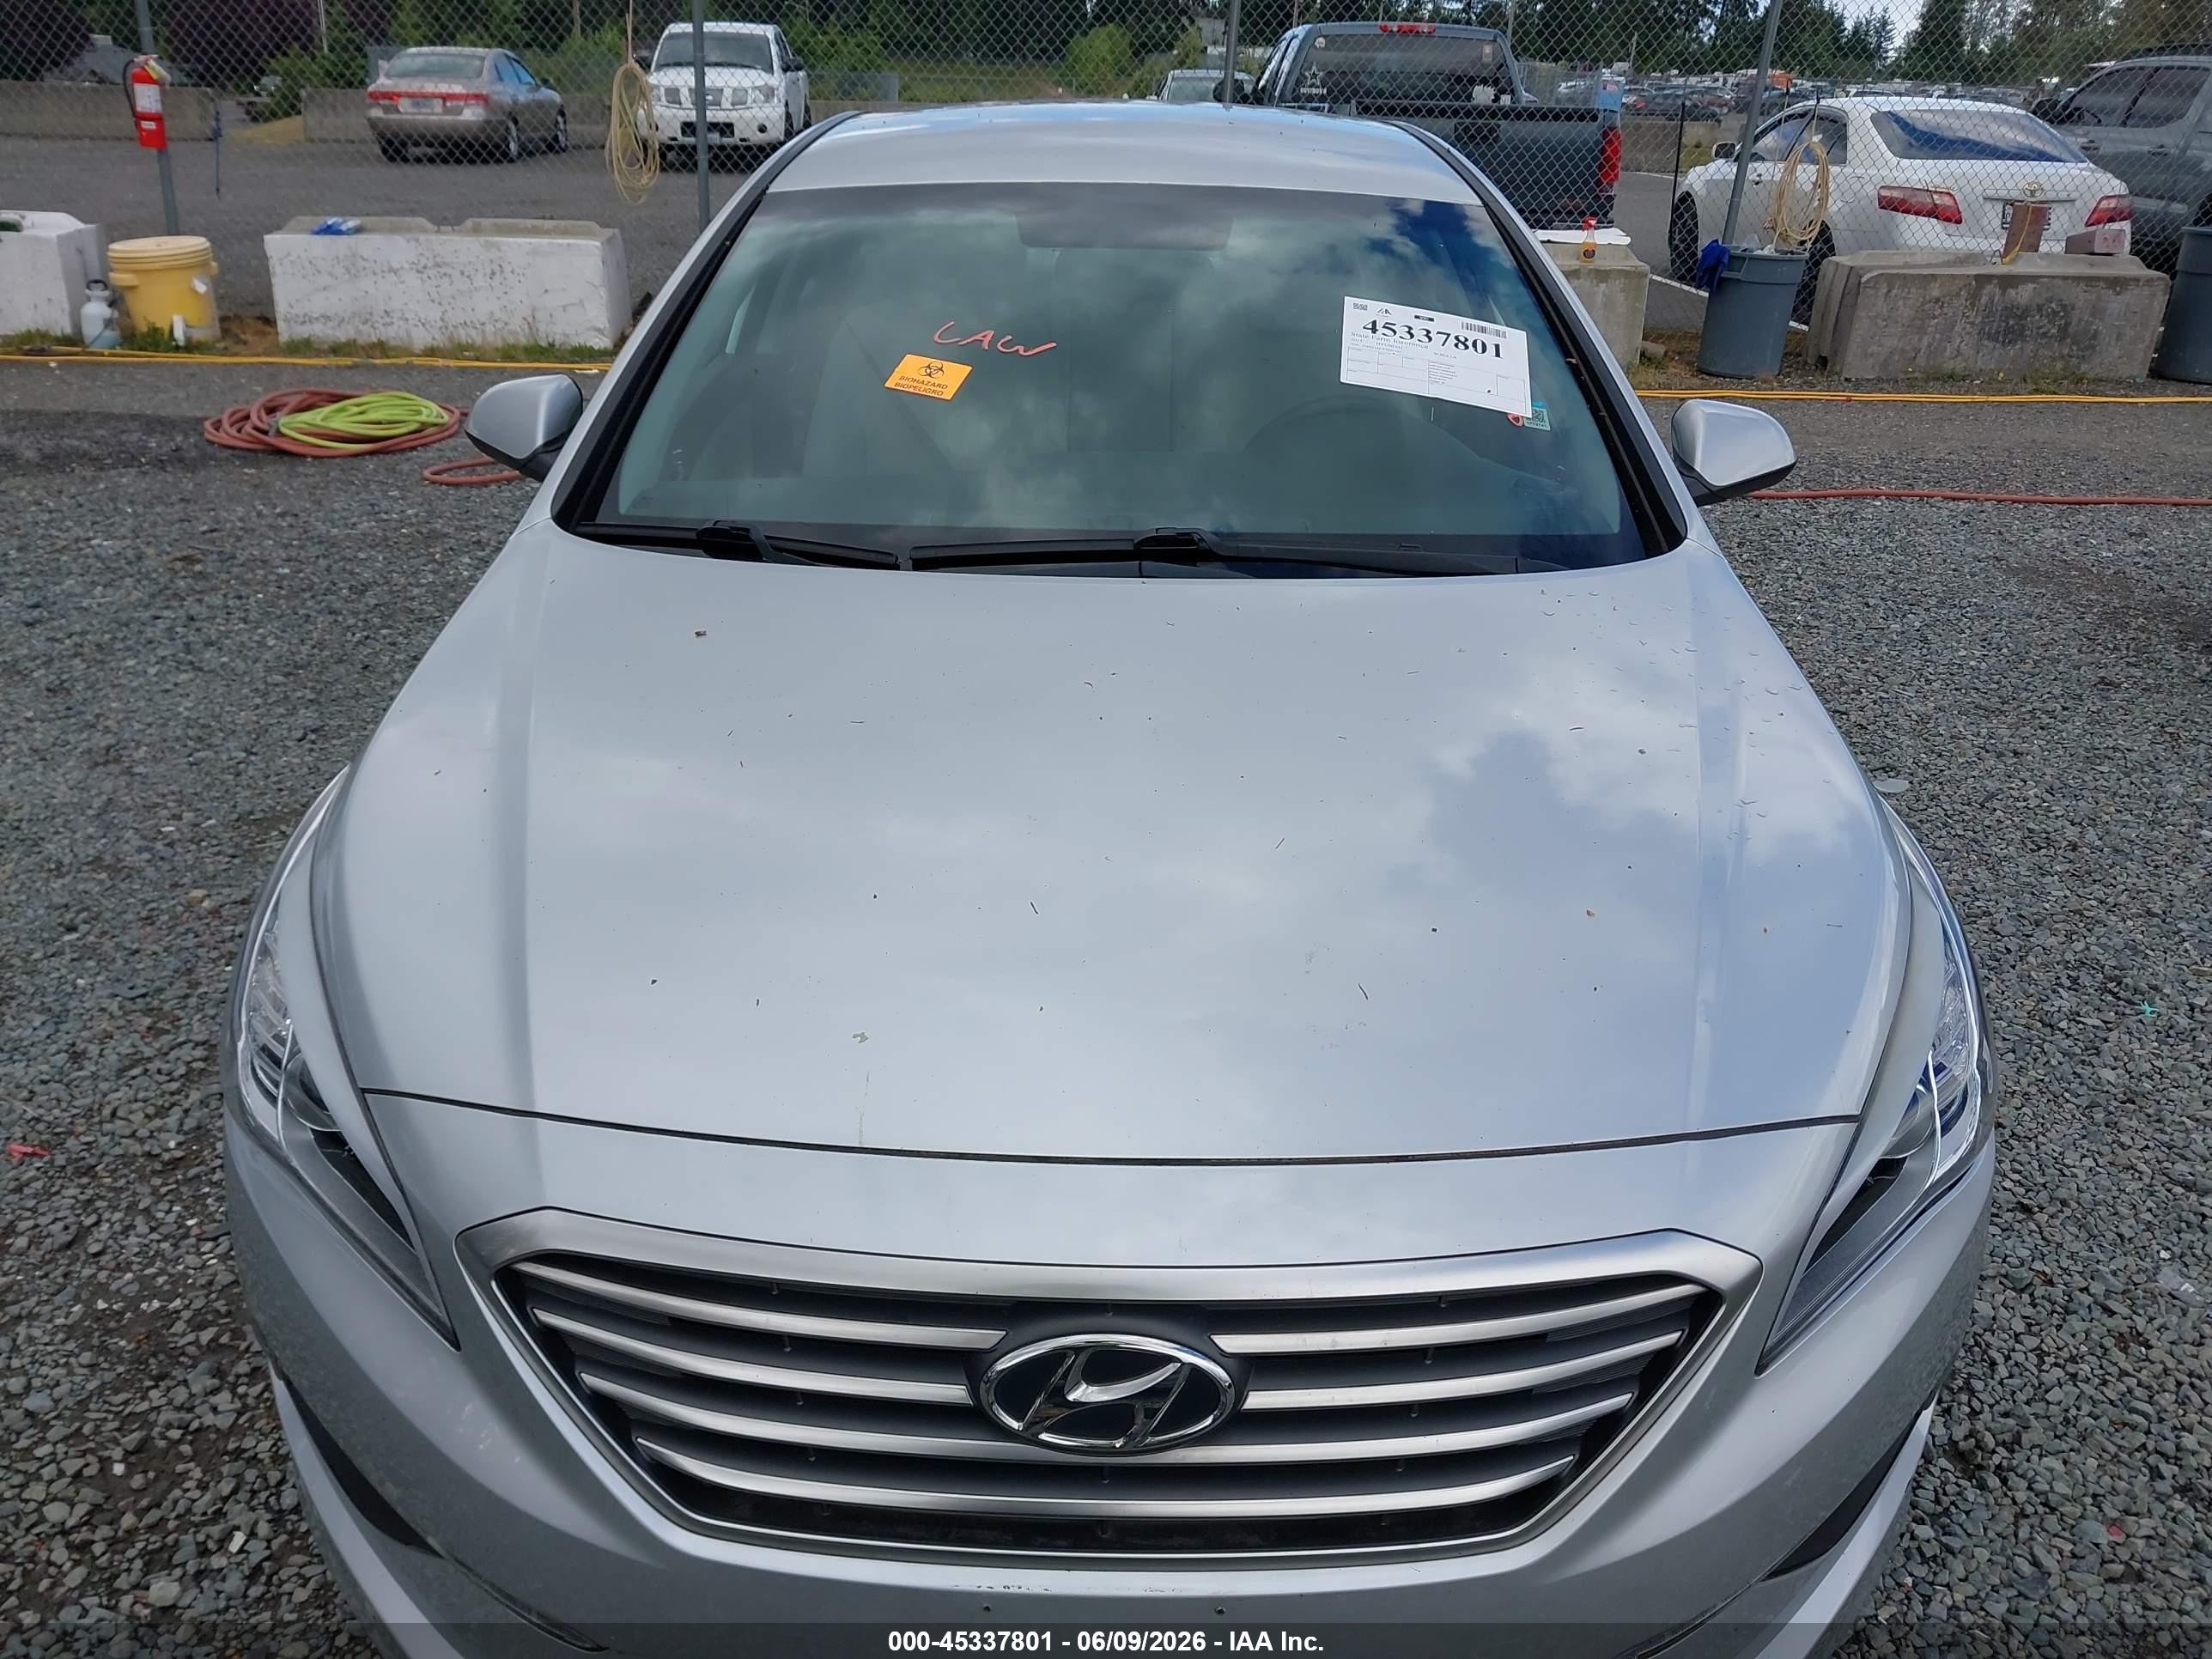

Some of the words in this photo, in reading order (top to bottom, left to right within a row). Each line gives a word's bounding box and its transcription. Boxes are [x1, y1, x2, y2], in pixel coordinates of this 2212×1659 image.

[1362, 319, 1504, 359] 45337801
[1371, 334, 1391, 343] Farm
[1393, 338, 1429, 349] Insurance
[894, 382, 944, 396] BIOPELIGRO
[899, 375, 948, 389] BIOHAZARD
